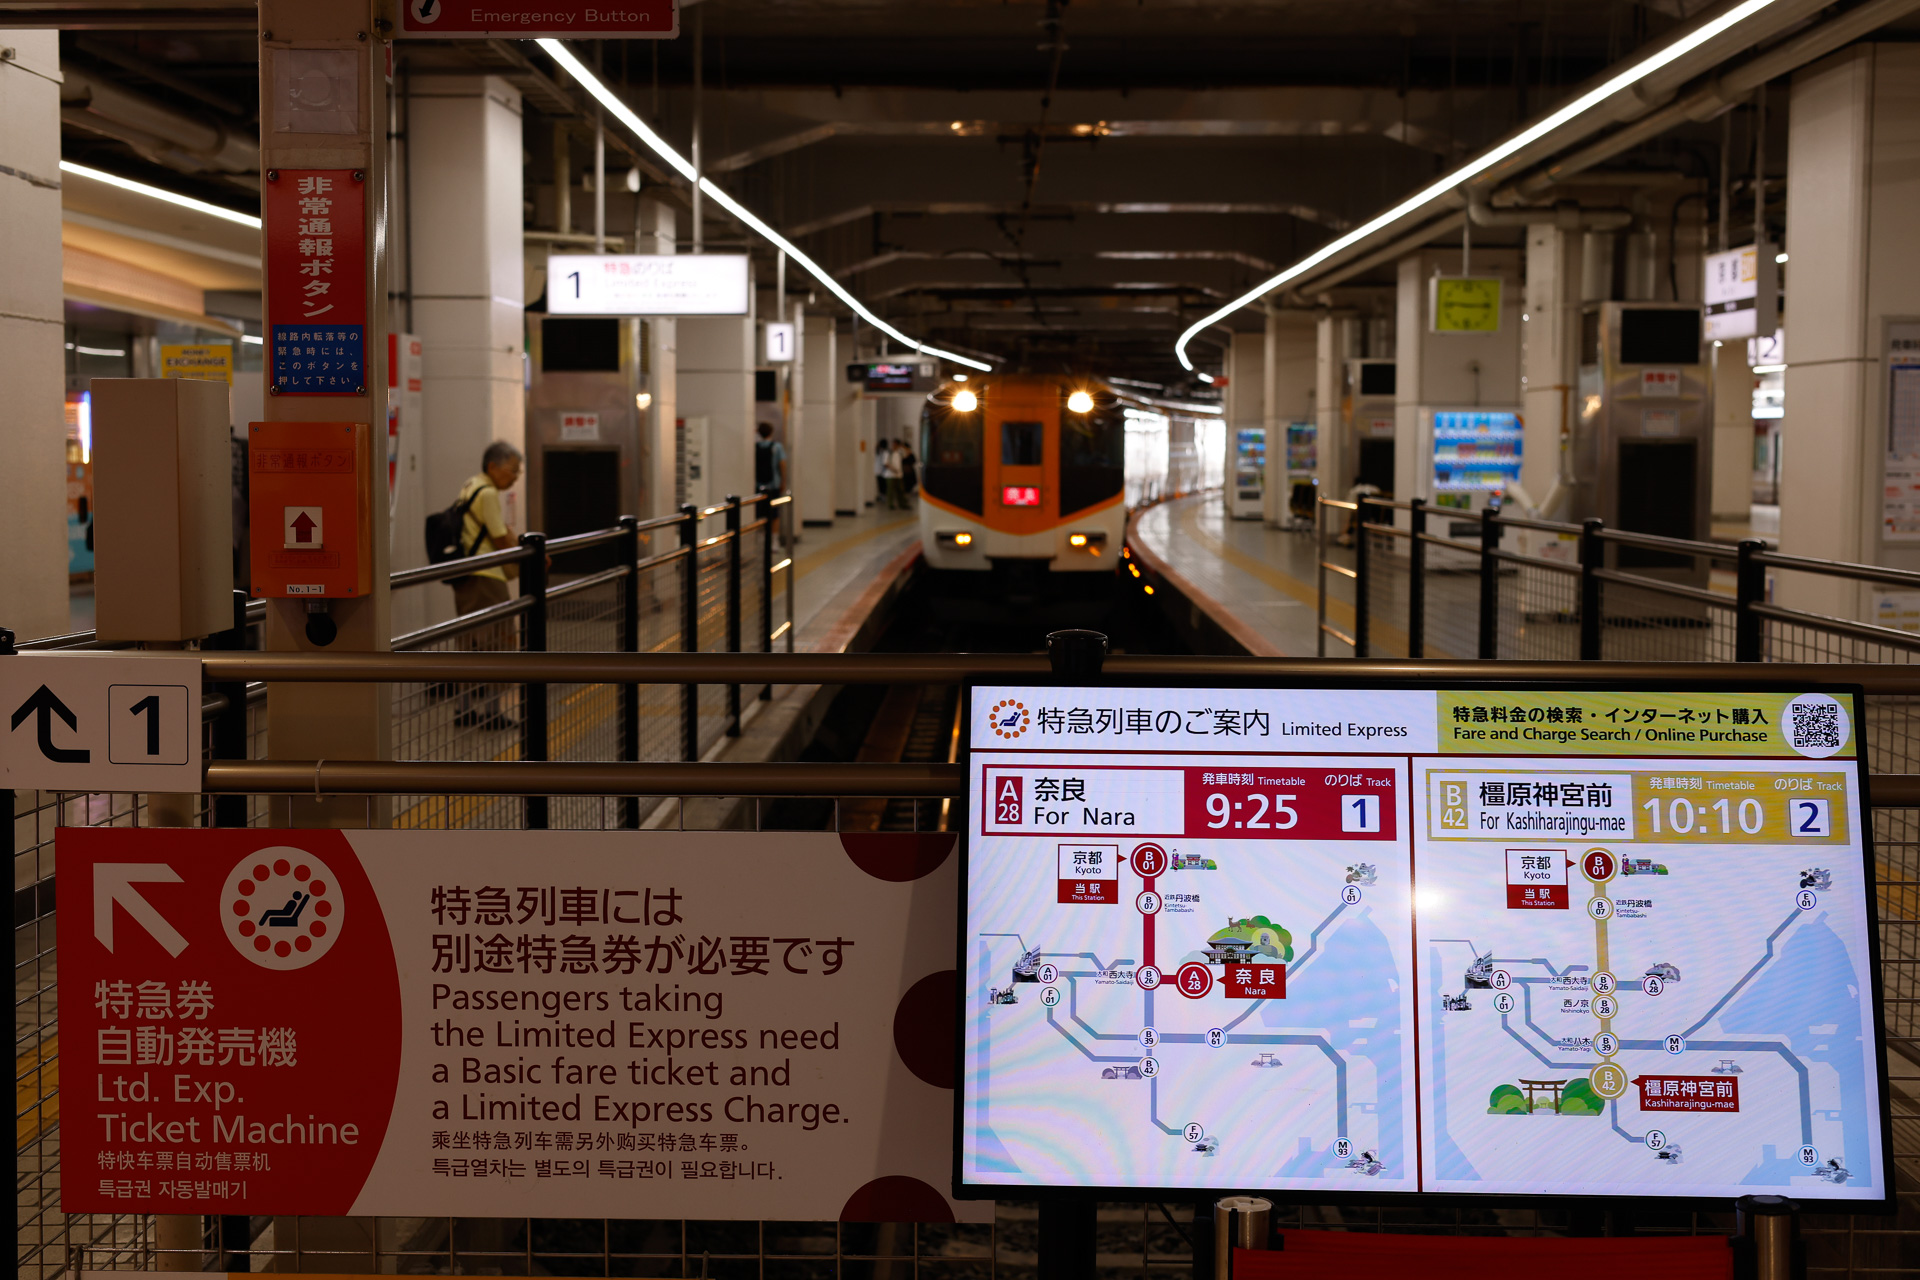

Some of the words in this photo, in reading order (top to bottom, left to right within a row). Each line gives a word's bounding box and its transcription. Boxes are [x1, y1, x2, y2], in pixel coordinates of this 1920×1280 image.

[471, 9, 576, 24] Emergency
[585, 9, 650, 22] Button
[297, 176, 335, 318] 非常通報ボタン
[568, 271, 580, 299] 1
[277, 332, 358, 342] 線路内転落等の
[774, 333, 784, 352] 1
[277, 346, 353, 356] 緊急時には、
[1761, 336, 1777, 358] 2
[278, 361, 358, 371] このボタンを
[256, 452, 348, 468] 非常通報ボタン
[129, 695, 159, 755] 1
[1037, 707, 1270, 738] 特急列車のご案内
[1453, 706, 1769, 726] 特急料金の検索・インターネット購入
[1282, 722, 1342, 738] Limited
[1348, 723, 1408, 740] Express
[1454, 727, 1486, 740] Fare
[1490, 727, 1518, 740] and
[1523, 727, 1577, 743] Charge
[1581, 727, 1630, 741] Search
[1645, 728, 1695, 742] Online
[1700, 728, 1768, 743] Purchase
[1202, 772, 1254, 786] 発車時刻
[1258, 776, 1306, 787] Timetable
[1324, 773, 1363, 787] のりば
[1367, 777, 1391, 787] Track
[1649, 776, 1702, 790] 発車時刻
[1706, 780, 1755, 791] Timetable
[1774, 778, 1813, 791] のりば
[1817, 781, 1842, 791] Track
[1000, 780, 1019, 800] A
[1034, 777, 1086, 802] 奈良
[1446, 785, 1461, 806] B
[1479, 781, 1613, 808] 橿原神宮前
[998, 803, 1020, 822] 28
[1034, 807, 1069, 825] For
[1084, 808, 1135, 826] Nara
[1206, 793, 1299, 830] 9:25
[1351, 799, 1367, 828] 1
[1443, 808, 1465, 827] 42
[1643, 797, 1764, 834] 10:10
[1799, 802, 1821, 832] 2
[1480, 812, 1500, 829] For
[1506, 812, 1626, 835] Kashiharajingu-mae
[1073, 851, 1102, 865] 京都
[1142, 861, 1155, 870] 01
[1146, 852, 1153, 861] B
[1521, 856, 1551, 870] 京都
[1595, 857, 1603, 866] B
[1075, 866, 1102, 876] Kyoto
[1524, 872, 1550, 881] Kyoto
[1592, 866, 1605, 875] 01
[430, 885, 683, 927] 特急列車には
[431, 933, 855, 976] 別途特急券が必要です
[1044, 973, 1053, 981] 01
[1189, 971, 1198, 980] A
[1188, 981, 1201, 990] 28
[1245, 987, 1266, 996] Nara
[94, 980, 214, 1020] 特急券
[432, 983, 609, 1018] Passengers
[619, 983, 724, 1019] taking
[97, 1025, 298, 1067] 自動発売機
[431, 1019, 485, 1048] the
[497, 1020, 616, 1049] Limited
[629, 1021, 748, 1055] Express
[760, 1021, 840, 1050] need
[1144, 1037, 1154, 1045] 39
[432, 1064, 449, 1084] a
[462, 1057, 542, 1085] Basic
[551, 1056, 617, 1086] fare
[627, 1057, 720, 1086] ticket
[729, 1058, 791, 1086] and
[1605, 1072, 1612, 1081] B
[97, 1072, 159, 1102] Ltd.
[174, 1074, 244, 1111] Exp.
[1602, 1081, 1616, 1090] 42
[1645, 1080, 1733, 1098] 橿原神宮前
[432, 1101, 449, 1120] a
[463, 1093, 581, 1122] Limited
[594, 1095, 712, 1129] Express
[724, 1095, 849, 1130] Charge.
[1645, 1099, 1734, 1109] Kashiharajingu-mae
[97, 1112, 200, 1143] Ticket
[213, 1114, 360, 1145] Machine
[431, 1131, 749, 1152] 乘坐特急列车需另外购买特急车票。
[97, 1150, 271, 1172] 特快车票自动售票机
[432, 1158, 526, 1178] 특급열차는
[534, 1159, 590, 1179] 별도의
[598, 1159, 672, 1179] 특급권이
[680, 1160, 783, 1180] 필요합니다.
[98, 1180, 151, 1198] 특급권
[158, 1180, 247, 1200] 자동발매기
